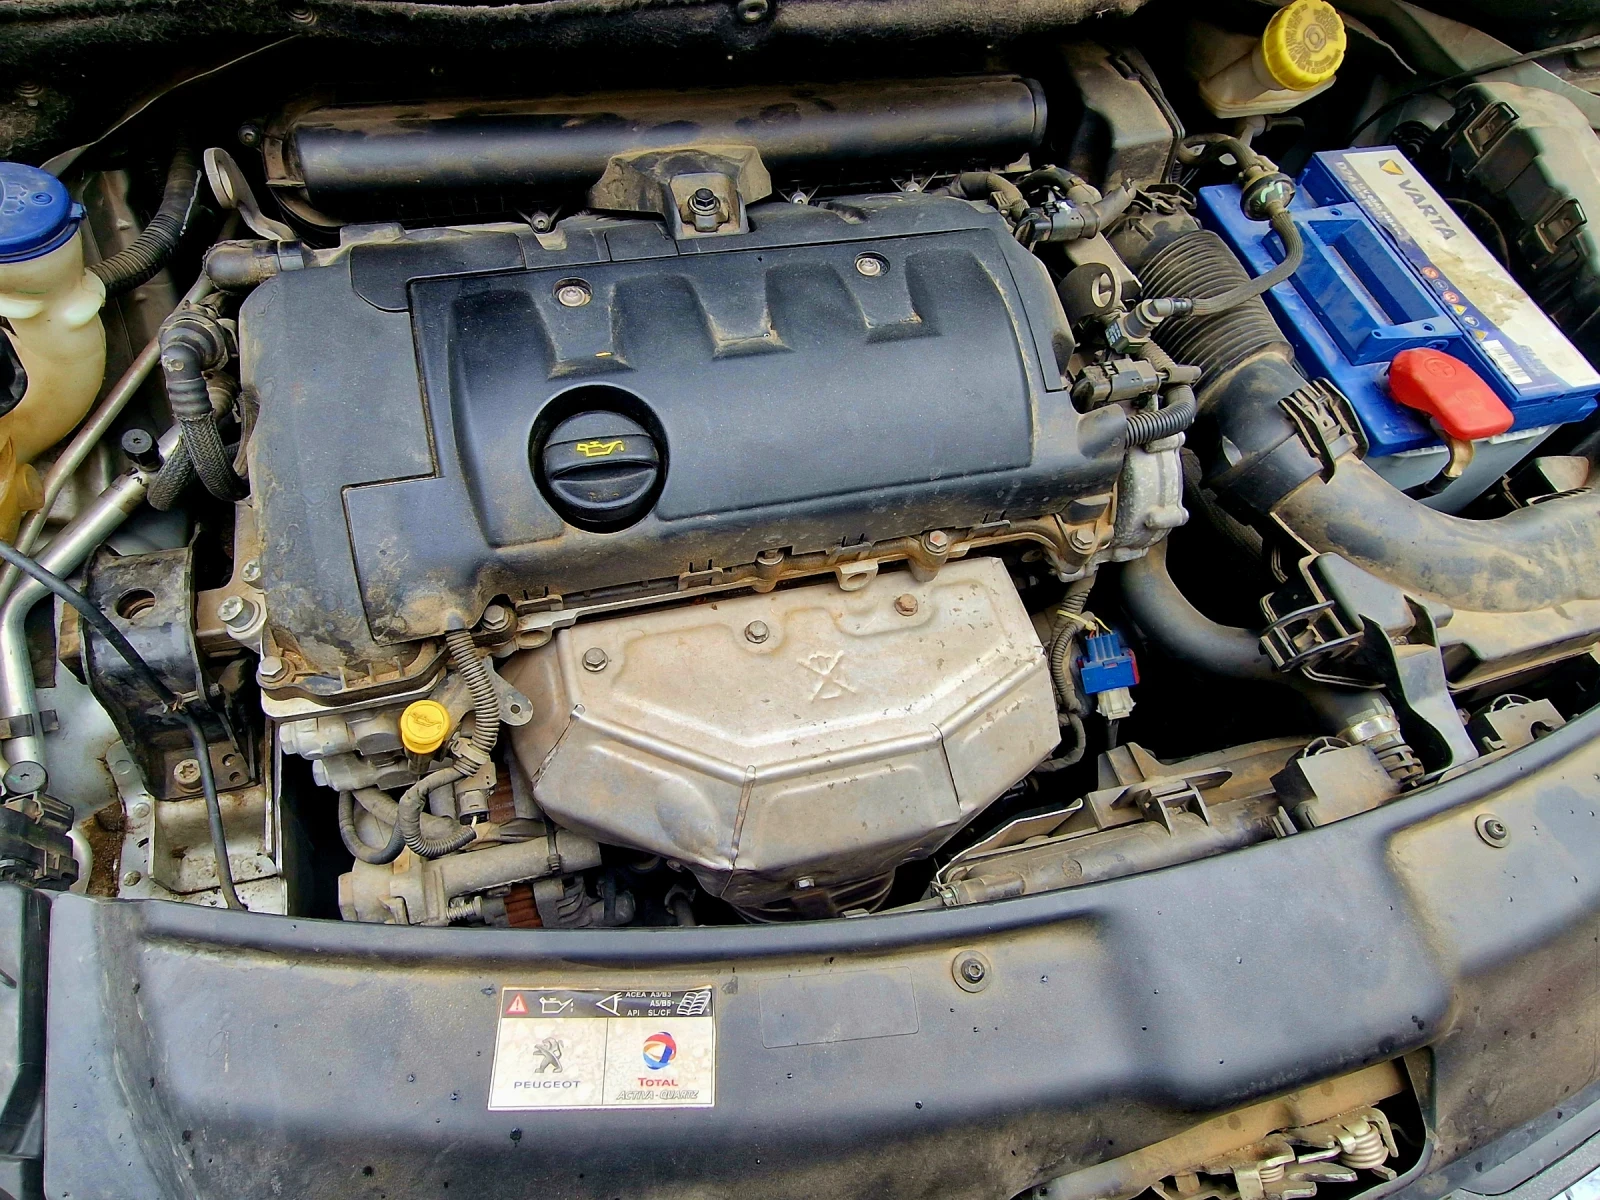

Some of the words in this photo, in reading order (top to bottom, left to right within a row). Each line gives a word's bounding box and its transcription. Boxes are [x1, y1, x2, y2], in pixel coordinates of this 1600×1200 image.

[1398, 179, 1457, 240] VARTA
[514, 1080, 581, 1089] PEUGEOT
[638, 1077, 678, 1087] TOTAL
